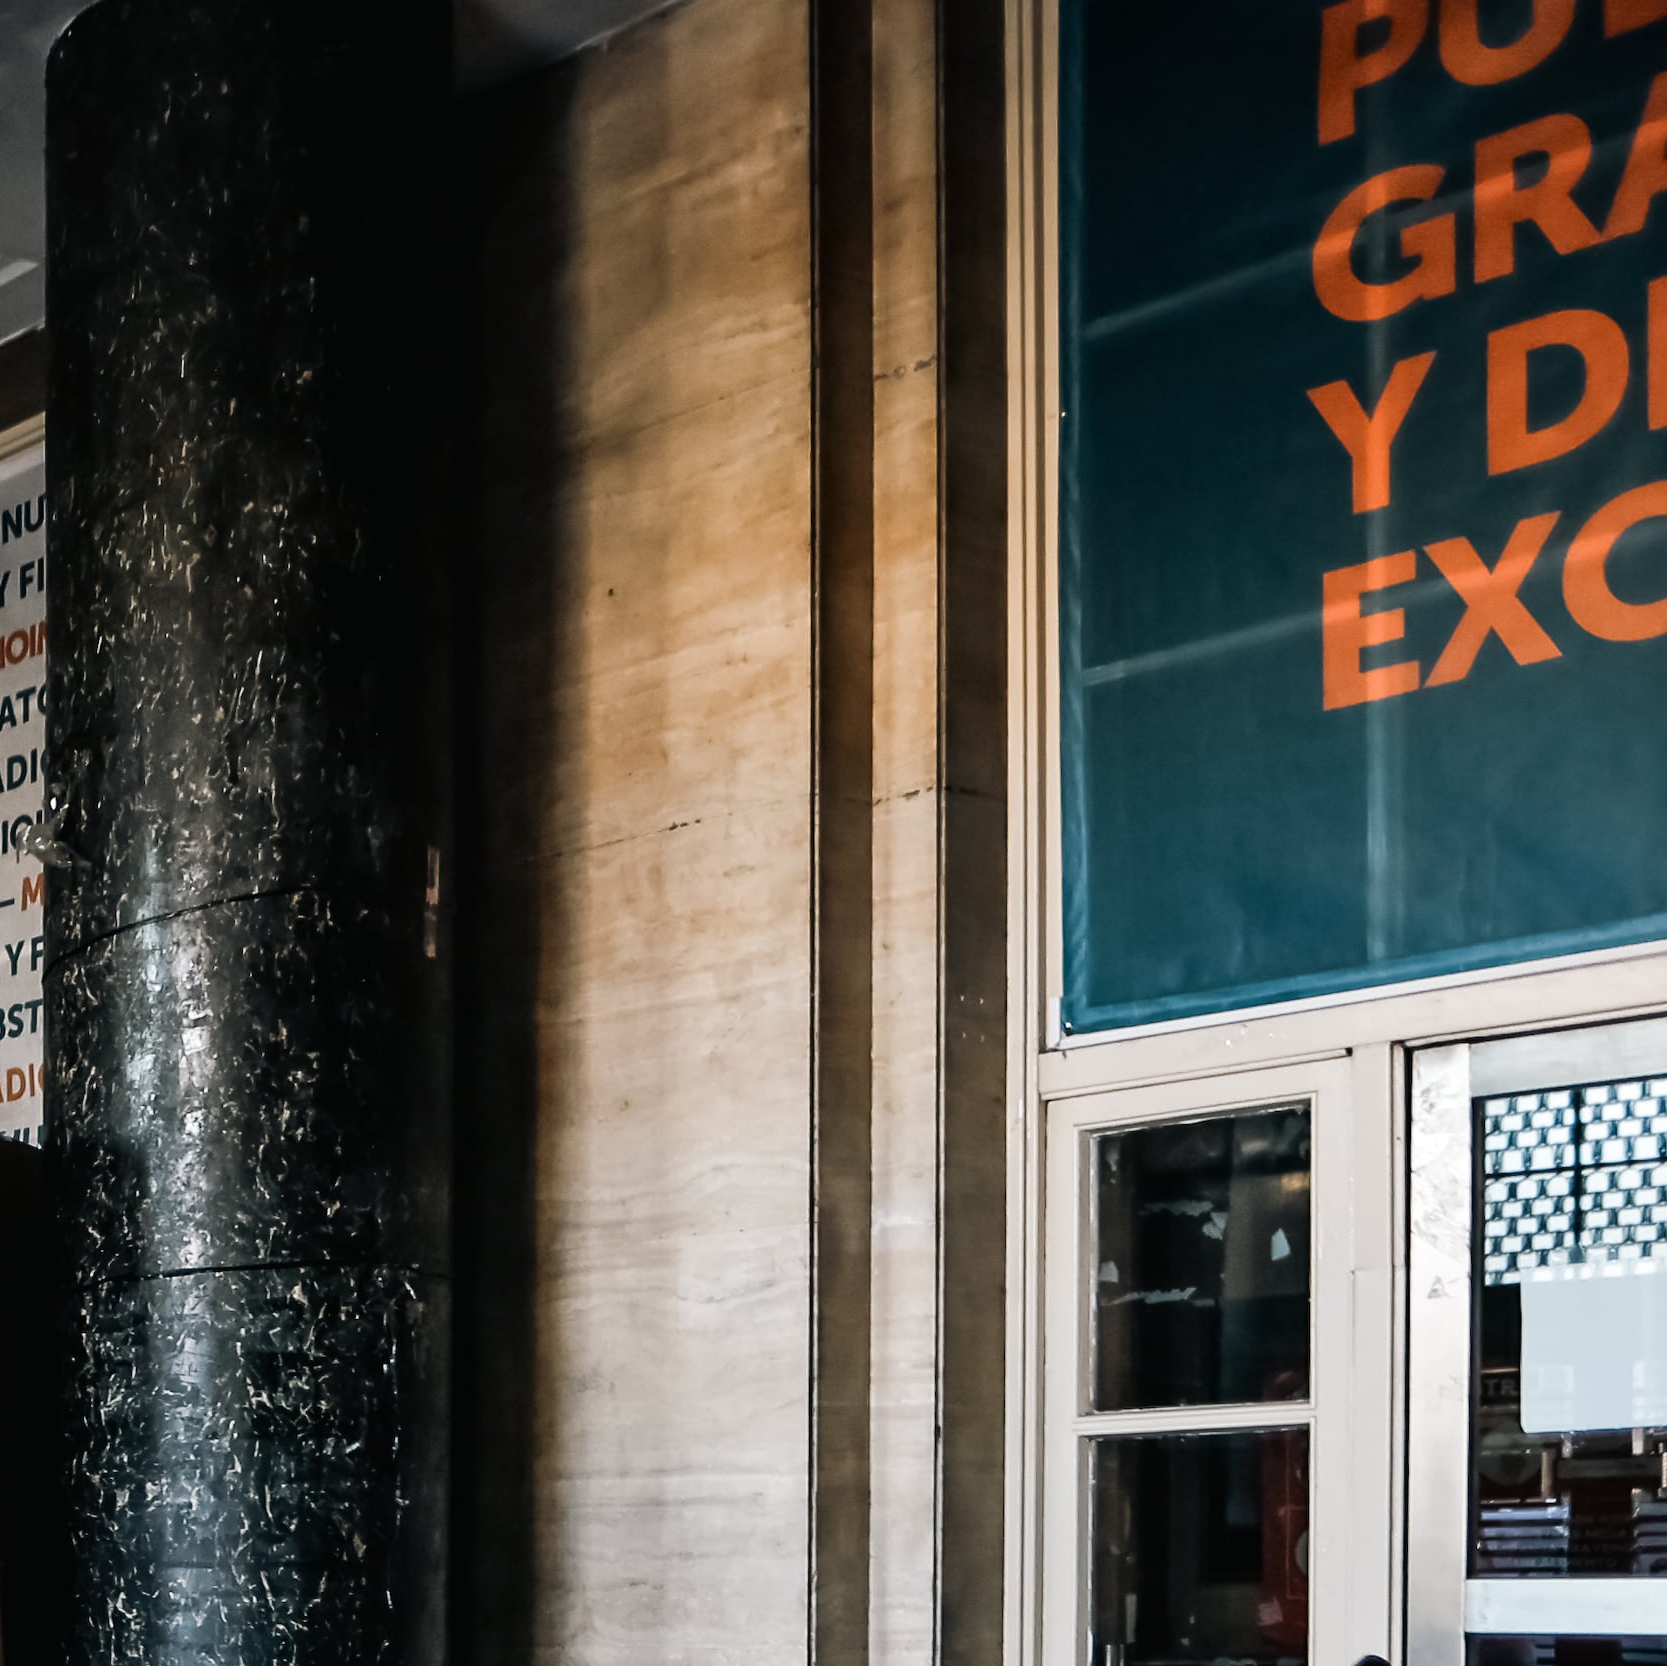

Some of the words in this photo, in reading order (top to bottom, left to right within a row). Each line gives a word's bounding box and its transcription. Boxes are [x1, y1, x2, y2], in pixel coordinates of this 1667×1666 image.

[1307, 351, 1437, 514] Y
[1487, 275, 1667, 476] D
[2, 494, 44, 545] NU
[20, 557, 44, 599] FI
[1323, 480, 1667, 711] EXC
[5, 941, 25, 976] Y
[31, 935, 44, 971] F
